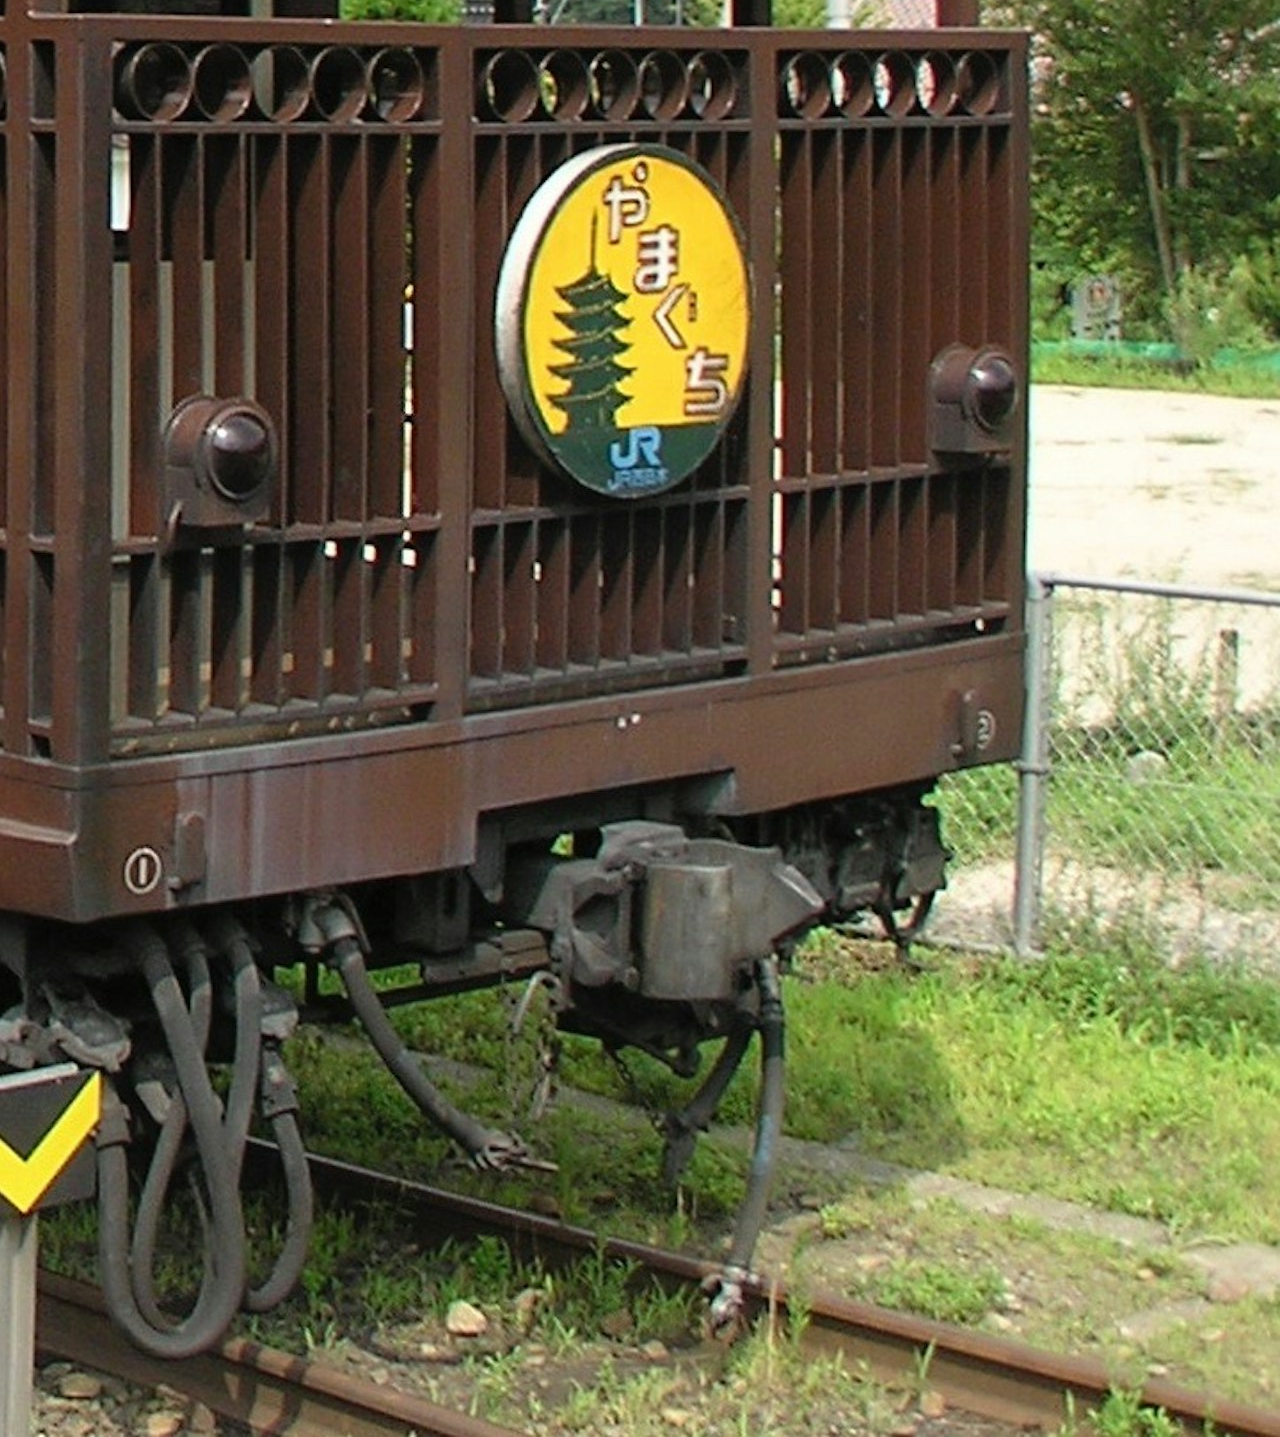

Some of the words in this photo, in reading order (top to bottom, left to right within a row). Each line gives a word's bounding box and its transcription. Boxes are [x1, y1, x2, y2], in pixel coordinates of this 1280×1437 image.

[603, 161, 730, 416] やまぐち
[611, 428, 661, 468] JR
